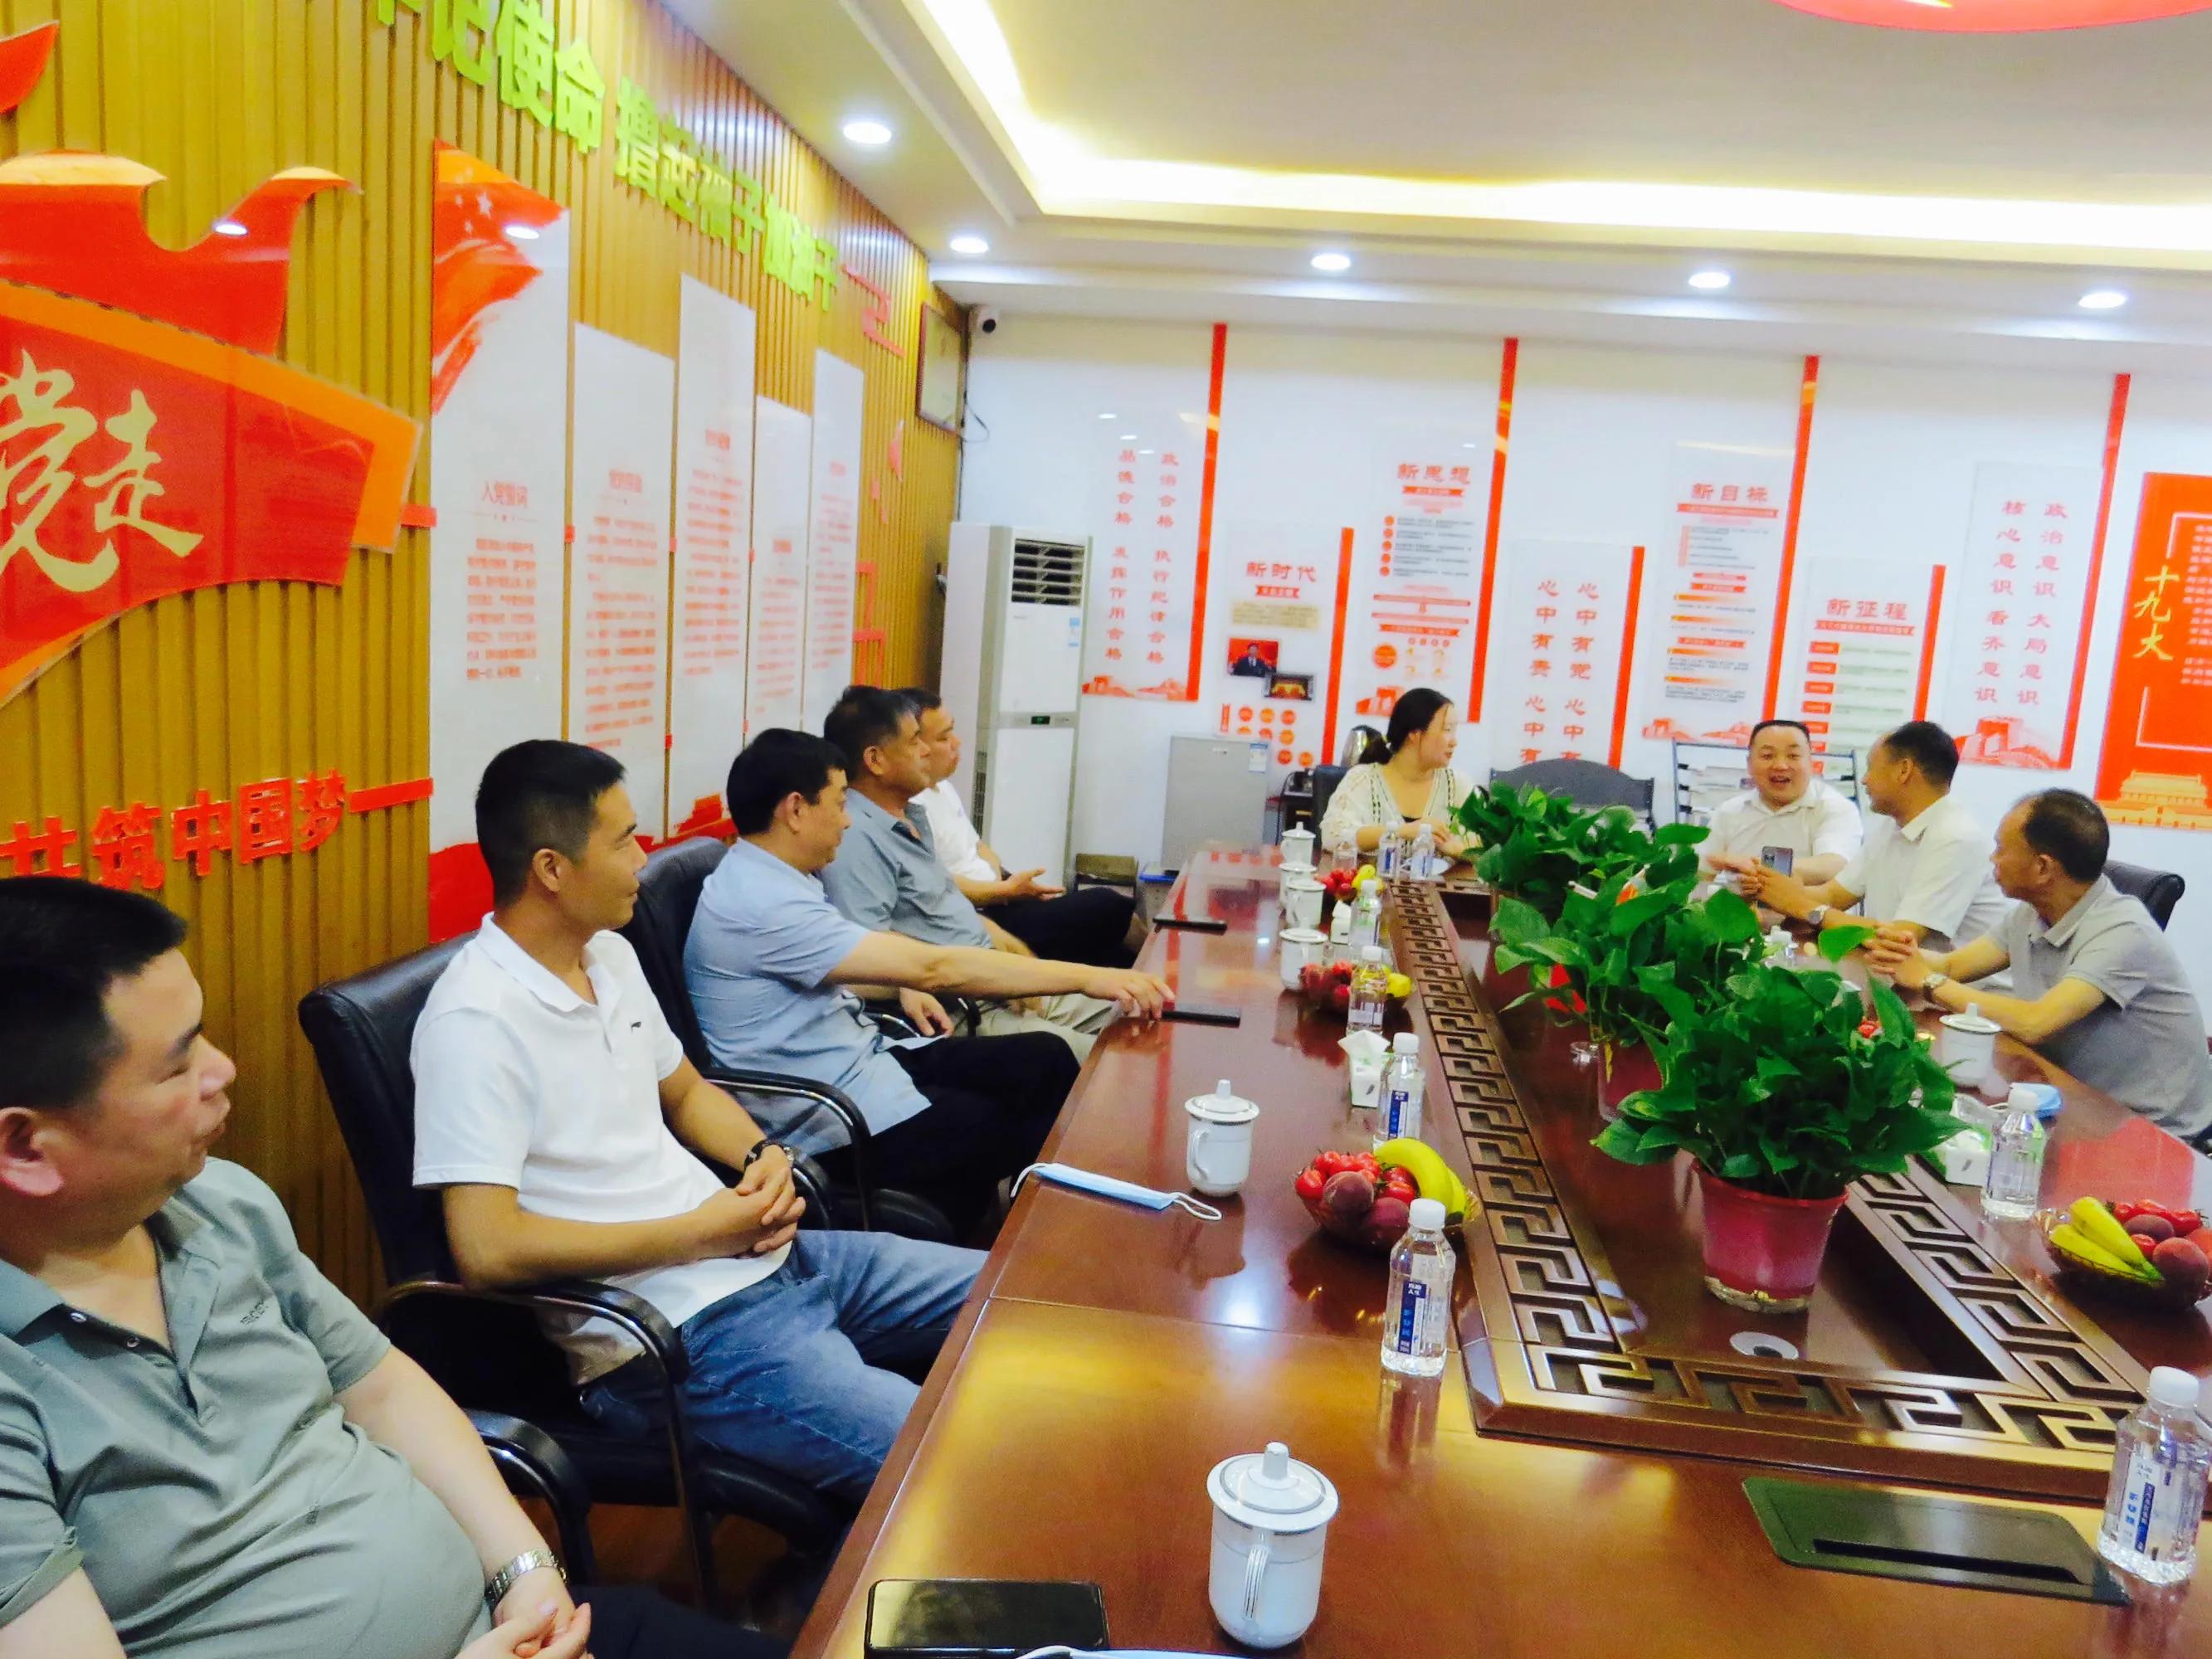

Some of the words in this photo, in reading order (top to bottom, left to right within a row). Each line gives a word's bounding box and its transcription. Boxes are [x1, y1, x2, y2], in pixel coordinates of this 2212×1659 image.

[376, 0, 606, 154] 记使命
[1397, 464, 1470, 484] 新思想
[1692, 483, 1768, 502] 新目标
[1246, 562, 1316, 582] 新时代
[1990, 500, 2026, 596] 核心意识
[2035, 503, 2068, 597] 政治意识
[1827, 598, 1907, 620] 新征程
[2133, 565, 2180, 661] 十九大
[1975, 610, 2009, 703] 看齐意识
[2018, 613, 2050, 705] 大局意识
[0, 768, 346, 889] 共筑中国梦
